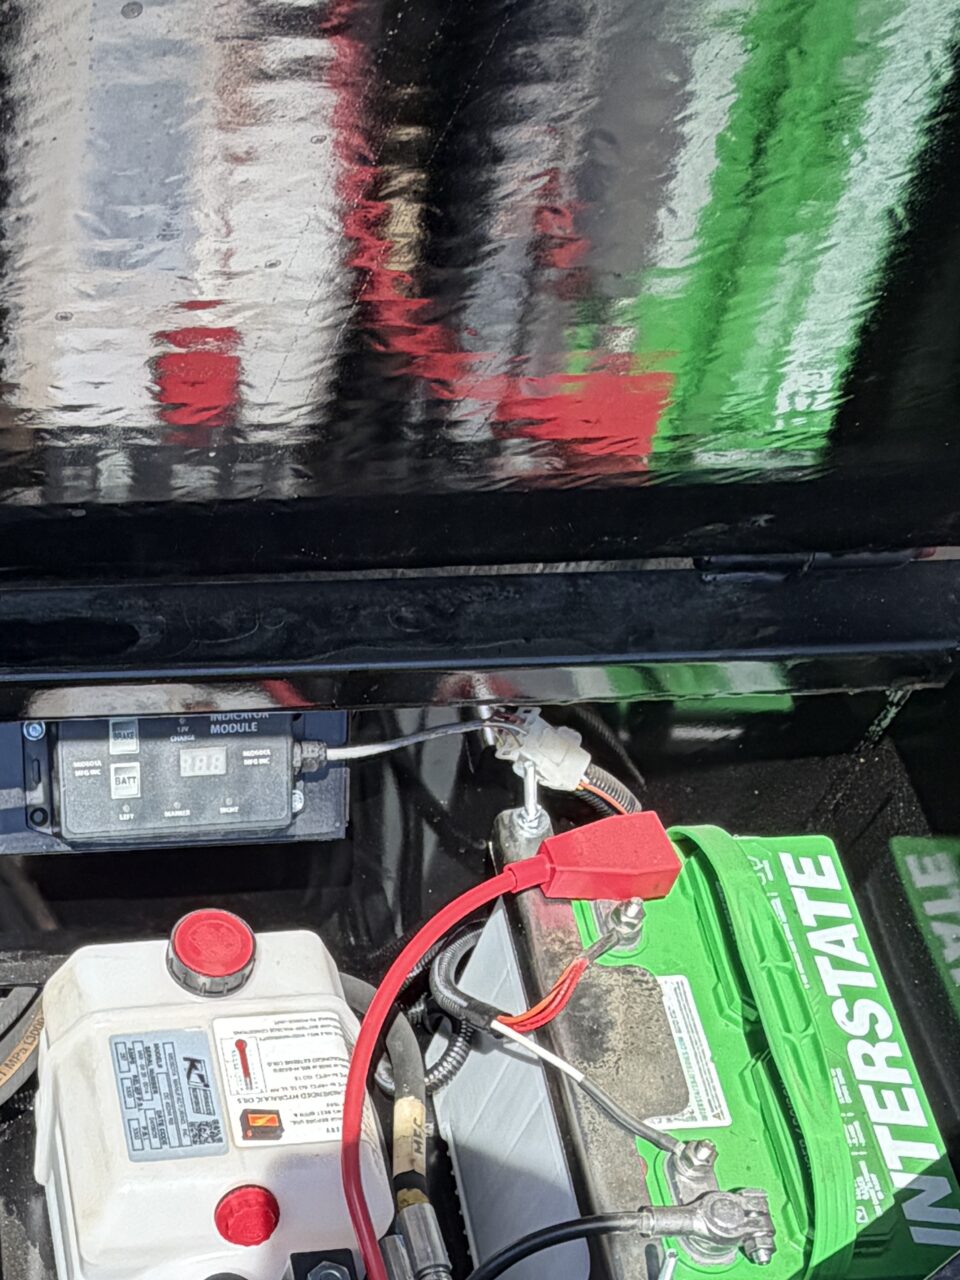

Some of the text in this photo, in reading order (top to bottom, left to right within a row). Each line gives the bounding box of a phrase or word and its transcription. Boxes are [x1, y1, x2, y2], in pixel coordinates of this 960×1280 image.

[210, 722, 258, 734] MODULE
[115, 776, 137, 786] BATT
[119, 813, 135, 821] LEFT
[780, 852, 960, 1247] INTERSTATE
